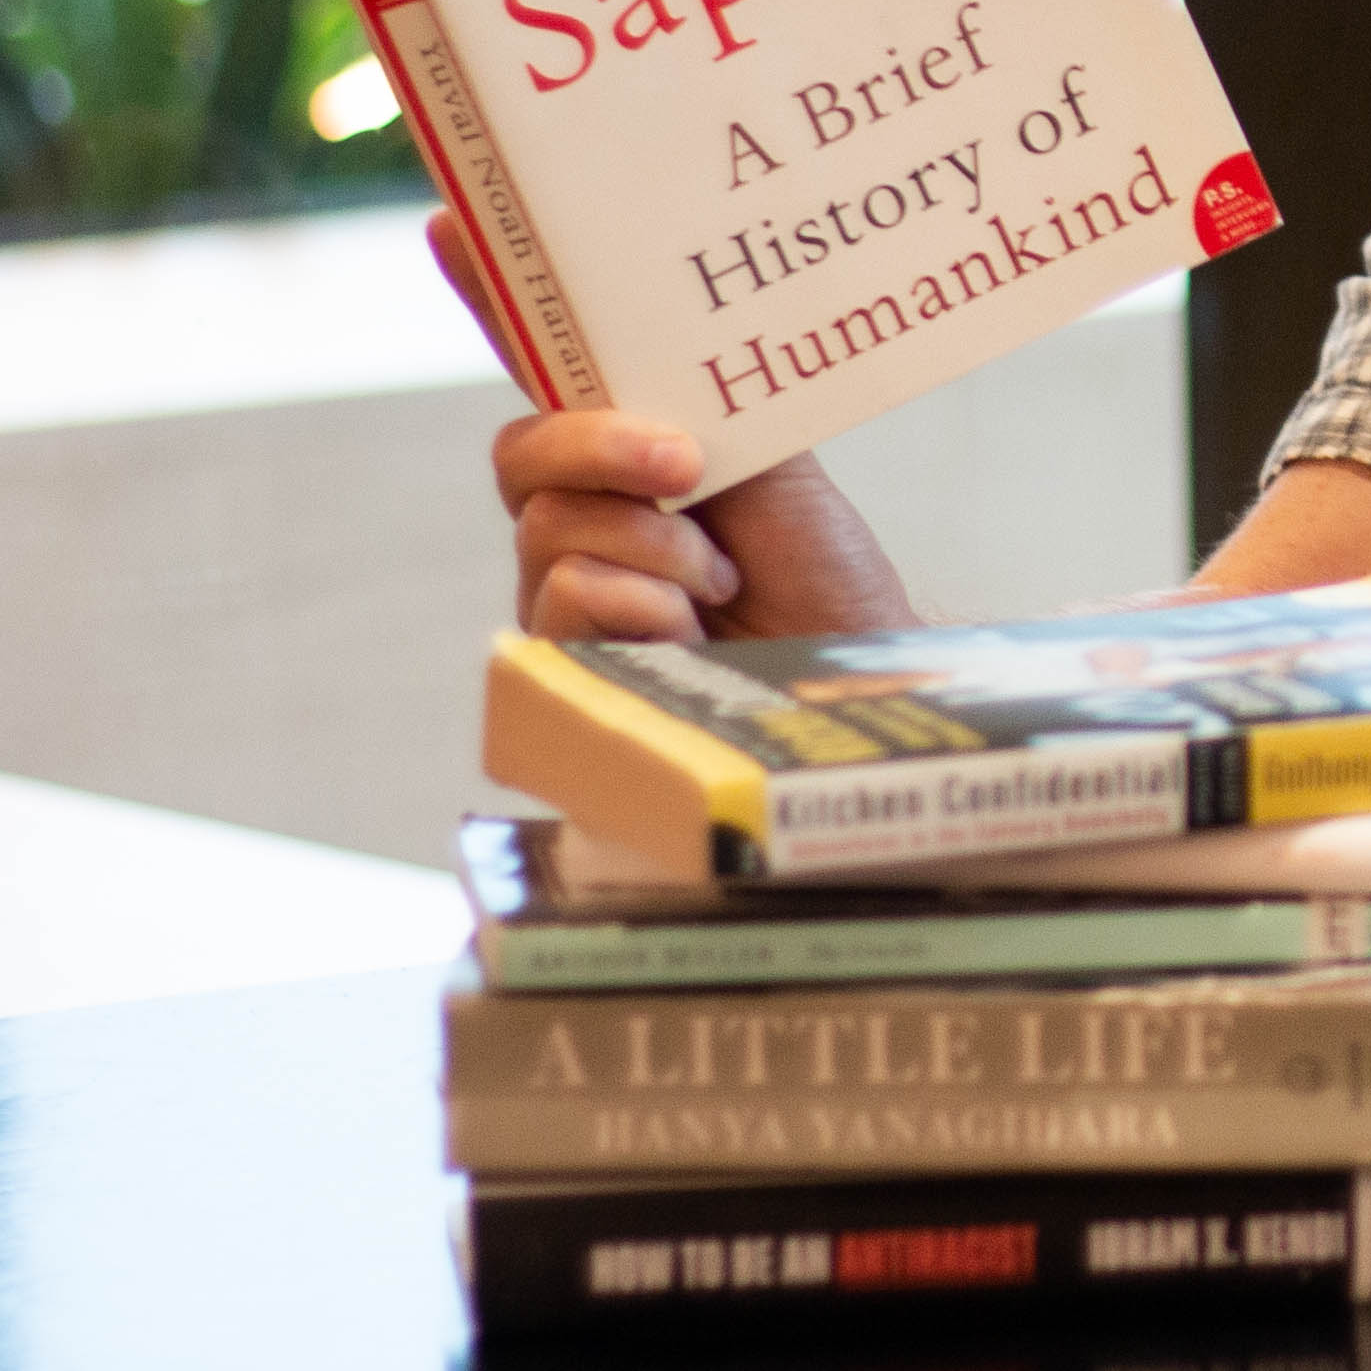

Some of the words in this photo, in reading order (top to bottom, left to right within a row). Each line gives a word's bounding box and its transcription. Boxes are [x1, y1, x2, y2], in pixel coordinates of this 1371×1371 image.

[728, 120, 787, 191] A
[791, 0, 994, 150] Brief
[419, 40, 483, 144] Yuval
[471, 154, 534, 260] Noah
[524, 272, 597, 398] Harari
[685, 138, 984, 313] History
[1017, 63, 1098, 156] of
[1201, 180, 1244, 208] P.S.
[699, 143, 1180, 419] Humankind
[774, 785, 924, 831] Kitchen
[938, 754, 1184, 819] Confidential
[528, 1017, 587, 1089] A
[624, 1010, 986, 1088] LITTLE
[1017, 1008, 1238, 1085] LIFE
[592, 1107, 790, 1152] HANYA
[805, 1103, 1180, 1151] YANAGIHARA
[590, 1241, 674, 1295] HOW
[680, 1239, 723, 1291] TO
[730, 1237, 776, 1289] BE
[780, 1234, 832, 1287] AN
[1244, 1210, 1347, 1265] KENDI
